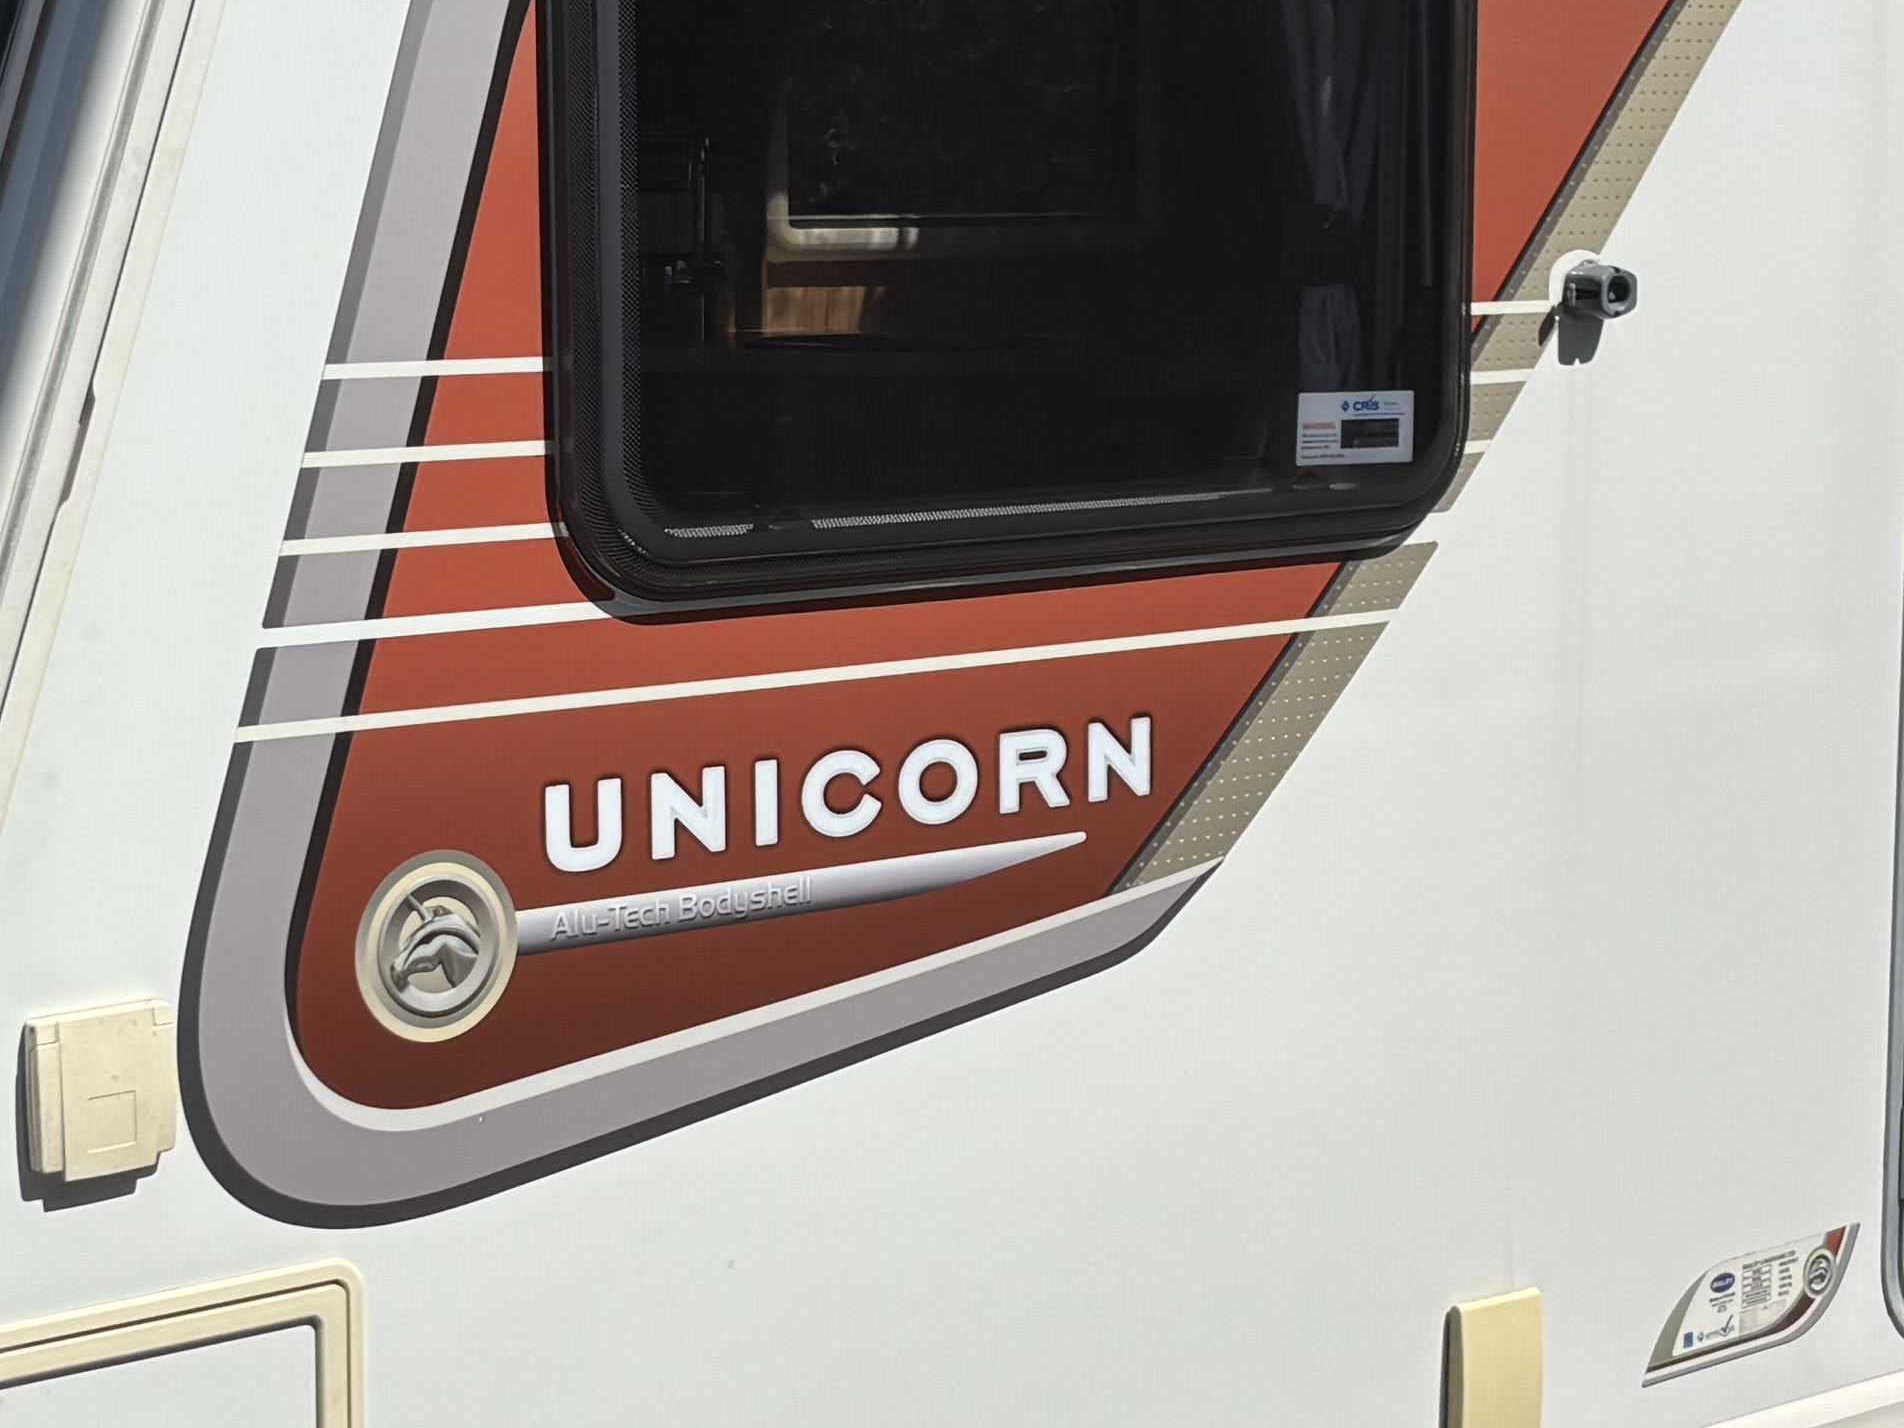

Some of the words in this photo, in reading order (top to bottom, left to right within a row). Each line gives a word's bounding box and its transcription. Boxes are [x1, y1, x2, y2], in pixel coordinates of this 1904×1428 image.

[544, 716, 1152, 873] UNICORN
[549, 899, 671, 941] Alu-Tech
[678, 875, 813, 921] Bodyshell
